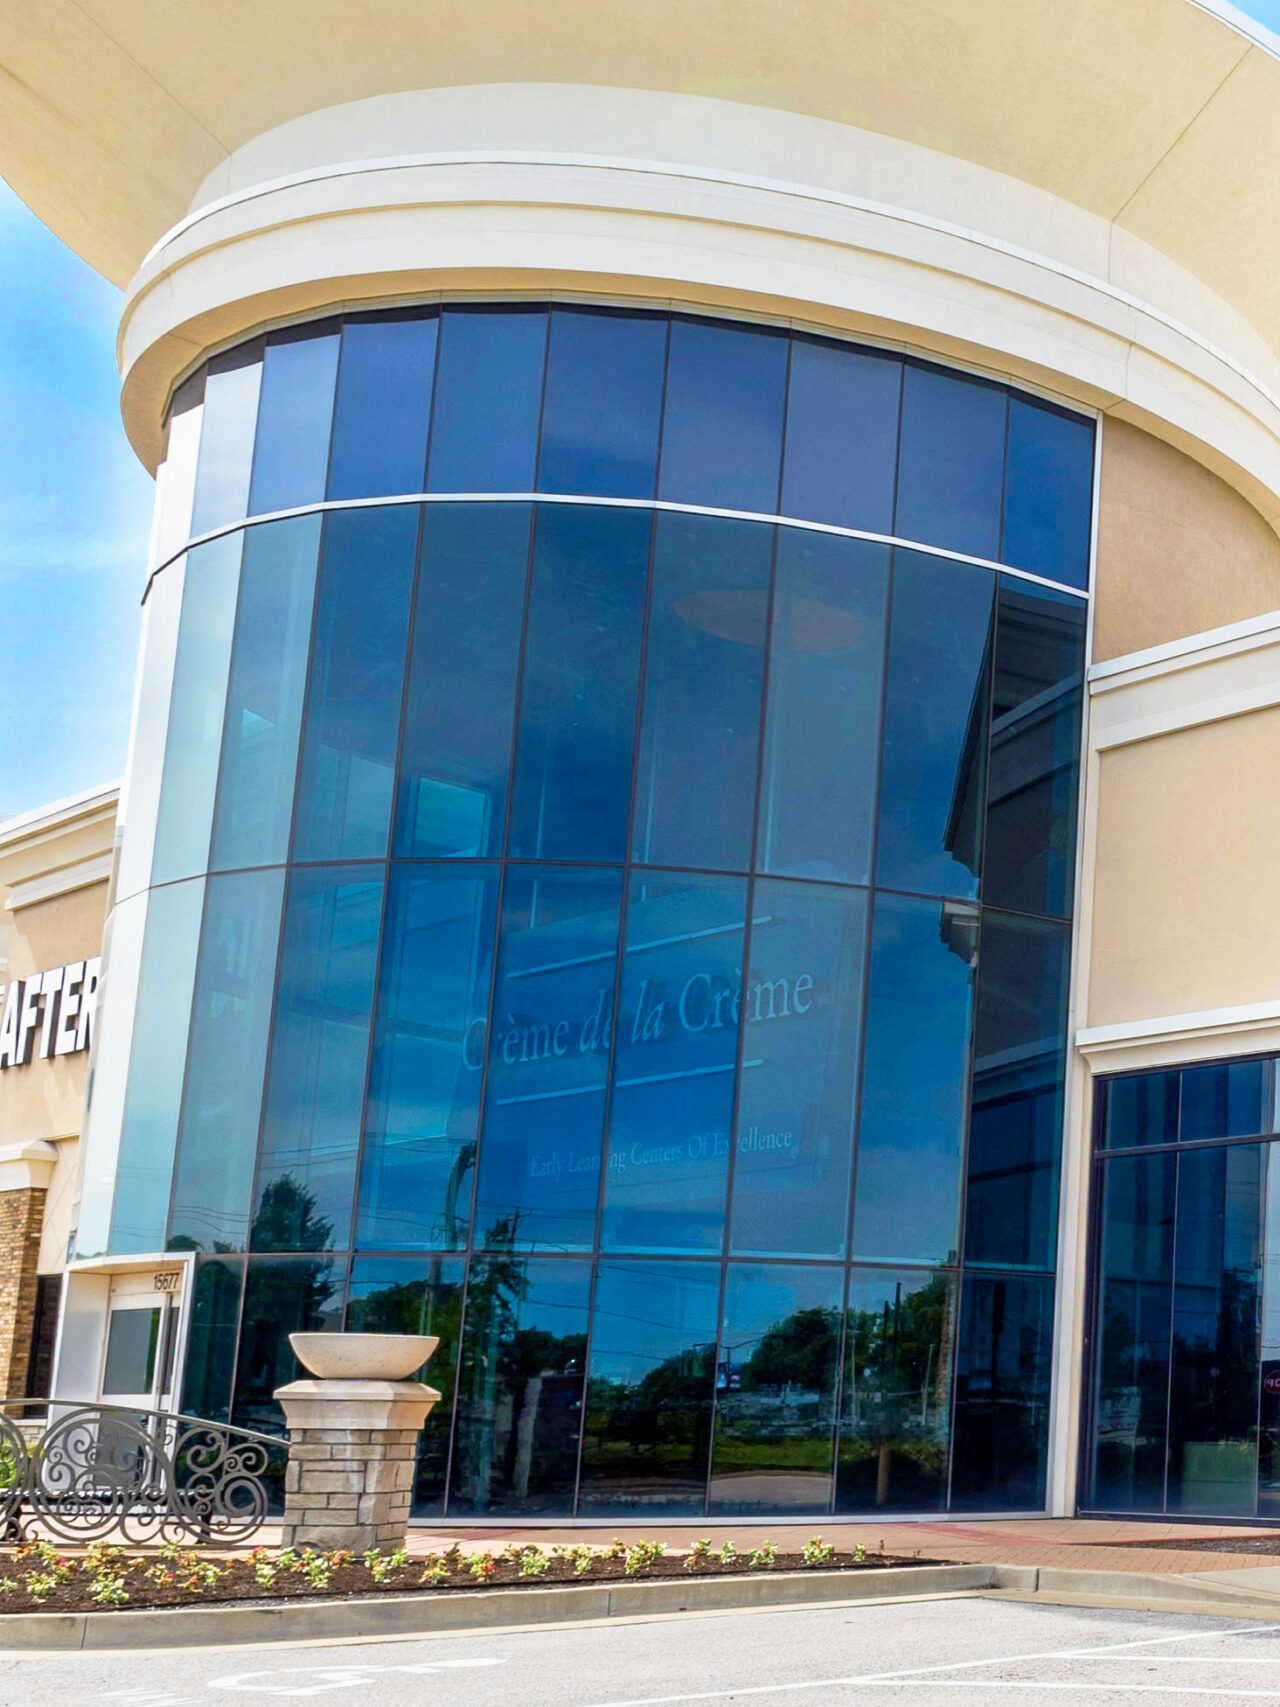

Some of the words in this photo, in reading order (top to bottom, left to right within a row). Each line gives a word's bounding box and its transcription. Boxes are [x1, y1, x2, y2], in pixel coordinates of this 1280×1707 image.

[0, 956, 102, 1069] AFTER
[631, 979, 665, 1044] la
[529, 1151, 562, 1180] Early
[630, 1142, 683, 1165] Centers
[154, 1272, 180, 1290] 15677
